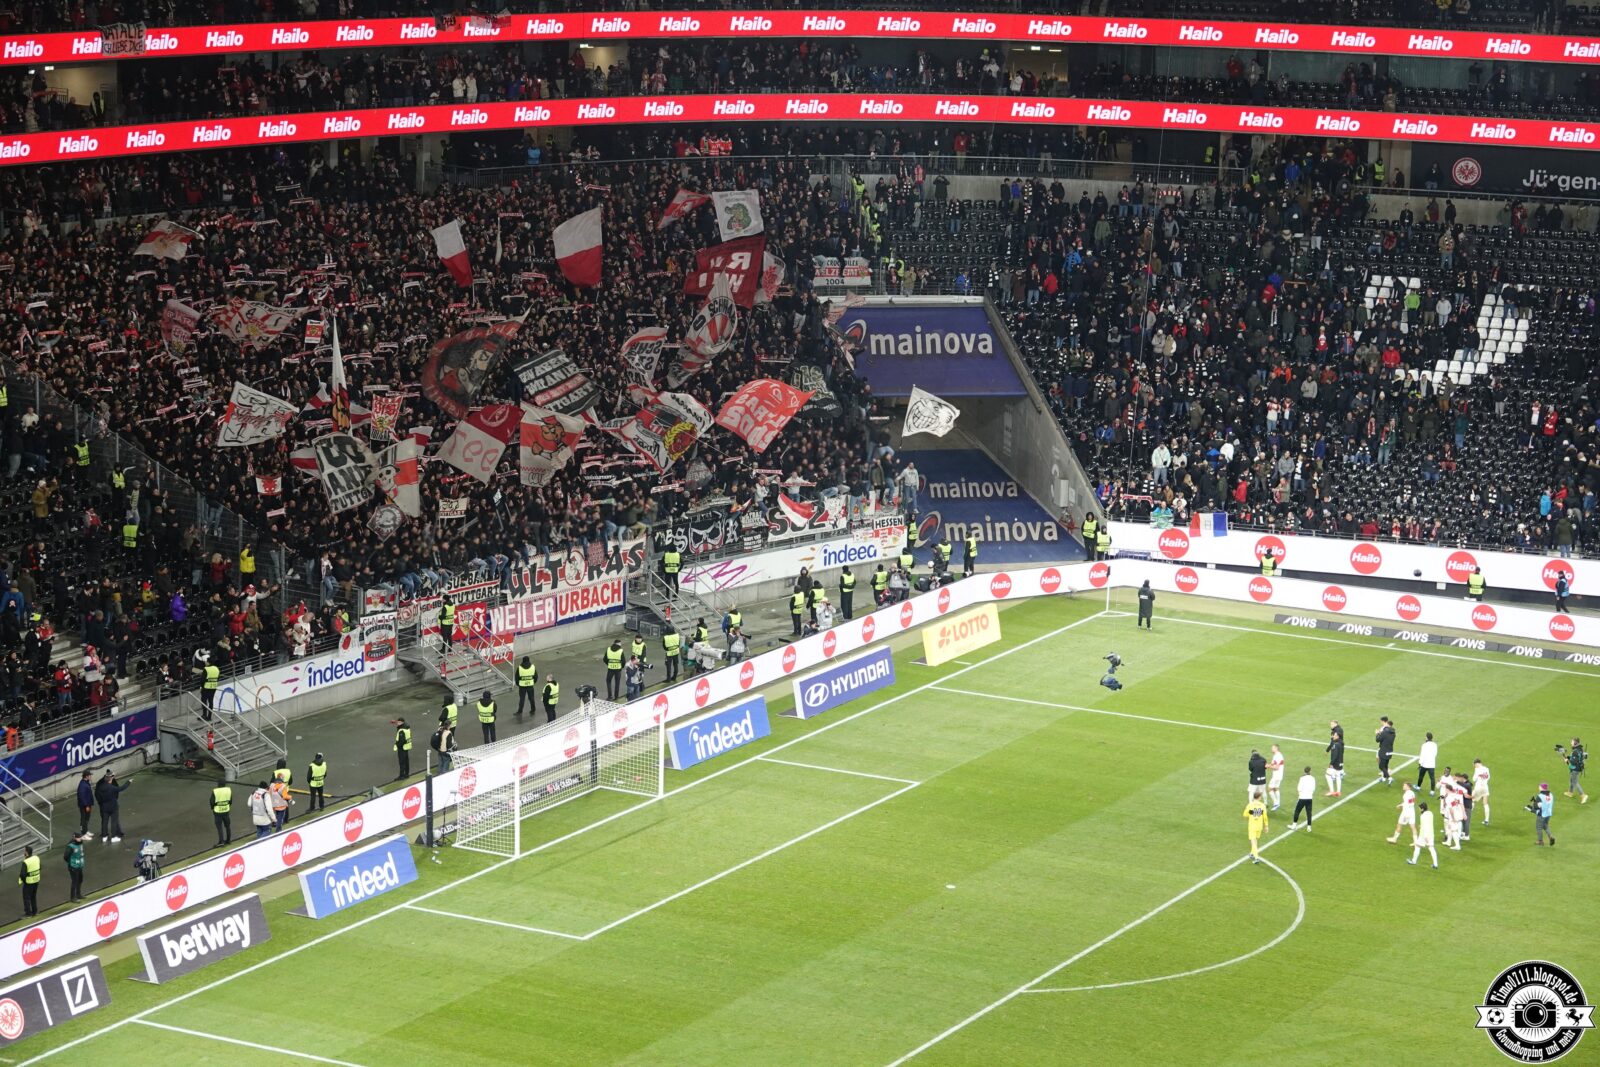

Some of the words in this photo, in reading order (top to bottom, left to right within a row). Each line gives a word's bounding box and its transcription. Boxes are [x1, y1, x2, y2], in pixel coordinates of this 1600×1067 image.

[400, 22, 438, 39] Hailo
[526, 18, 564, 35] Hailo
[591, 17, 631, 33] Hailo
[659, 16, 701, 32] Hailo
[729, 15, 773, 31] Hailo
[802, 15, 846, 31] Hailo
[876, 16, 921, 32] Hailo
[951, 17, 997, 34] Hailo
[1027, 19, 1073, 36] Hailo
[1103, 22, 1148, 39] Hailo
[205, 30, 244, 48] Hailo
[271, 27, 310, 45] Hailo
[335, 25, 374, 42] Hailo
[1178, 25, 1224, 42] Hailo
[1254, 27, 1300, 44] Hailo
[1330, 31, 1376, 48] Hailo
[3, 40, 44, 59] Hailo
[71, 36, 103, 55] Hail
[1407, 34, 1454, 52] Hailo
[1485, 37, 1532, 55] Hailo
[1563, 41, 1600, 58] Hail
[513, 105, 551, 122] Hailo
[577, 103, 616, 119] Hailo
[643, 100, 684, 117] Hailo
[713, 99, 755, 115] Hailo
[785, 99, 829, 114] Hailo
[859, 99, 904, 115] Hailo
[934, 100, 980, 116] Hailo
[1010, 101, 1056, 118] Hailo
[1086, 104, 1132, 121] Hailo
[387, 112, 425, 129] Hailo
[450, 108, 489, 126] Hailo
[1162, 107, 1208, 125] Hailo
[1238, 111, 1284, 128] Hailo
[1315, 115, 1361, 132] Hailo
[192, 124, 232, 143] Hailo
[258, 120, 297, 138] Hailo
[323, 116, 362, 134] Hailo
[1392, 118, 1439, 136] Hailo
[1470, 122, 1517, 140] Hailo
[126, 129, 166, 149] Hailo
[1548, 126, 1596, 144] Hailo
[58, 135, 99, 154] Hailo
[870, 325, 993, 356] mainova
[930, 477, 1018, 499] mainova
[875, 517, 903, 529] HESSEN
[944, 516, 1059, 542] mainova
[1160, 537, 1188, 549] Hailo
[1351, 552, 1381, 564] Hailo
[1447, 560, 1477, 572] Hailo
[1041, 575, 1060, 585] Hailo
[1176, 575, 1198, 584] Hailo
[1543, 569, 1574, 580] Halo
[991, 580, 1011, 590] Hailo
[1249, 584, 1272, 594] Hailo
[558, 581, 622, 617] URBACH
[1323, 593, 1346, 604] Hailo
[1396, 601, 1420, 613] Hailo
[490, 597, 556, 635] WEILER
[1290, 616, 1318, 628] DWS
[1472, 611, 1497, 622] Hailo
[953, 613, 990, 641] LOTTO
[1347, 623, 1372, 636] DWS
[1549, 621, 1574, 632] Hailo
[1403, 631, 1429, 643] DWS
[1458, 638, 1485, 651] DWS
[1516, 645, 1543, 658] DWS
[1573, 653, 1600, 666] DWS
[307, 652, 365, 688] indeed
[830, 658, 890, 697] HYUNDAI
[691, 710, 755, 760] indeed
[65, 723, 126, 767] indeed
[402, 796, 421, 810] Hailo
[344, 818, 364, 831] Hailo
[282, 842, 302, 856] Hailo
[223, 863, 245, 878] Hailo
[328, 851, 400, 908] indeed
[166, 884, 188, 900] Hailo
[96, 910, 119, 927] Hailo
[22, 938, 46, 955] Hailo
[160, 909, 251, 968] betway
